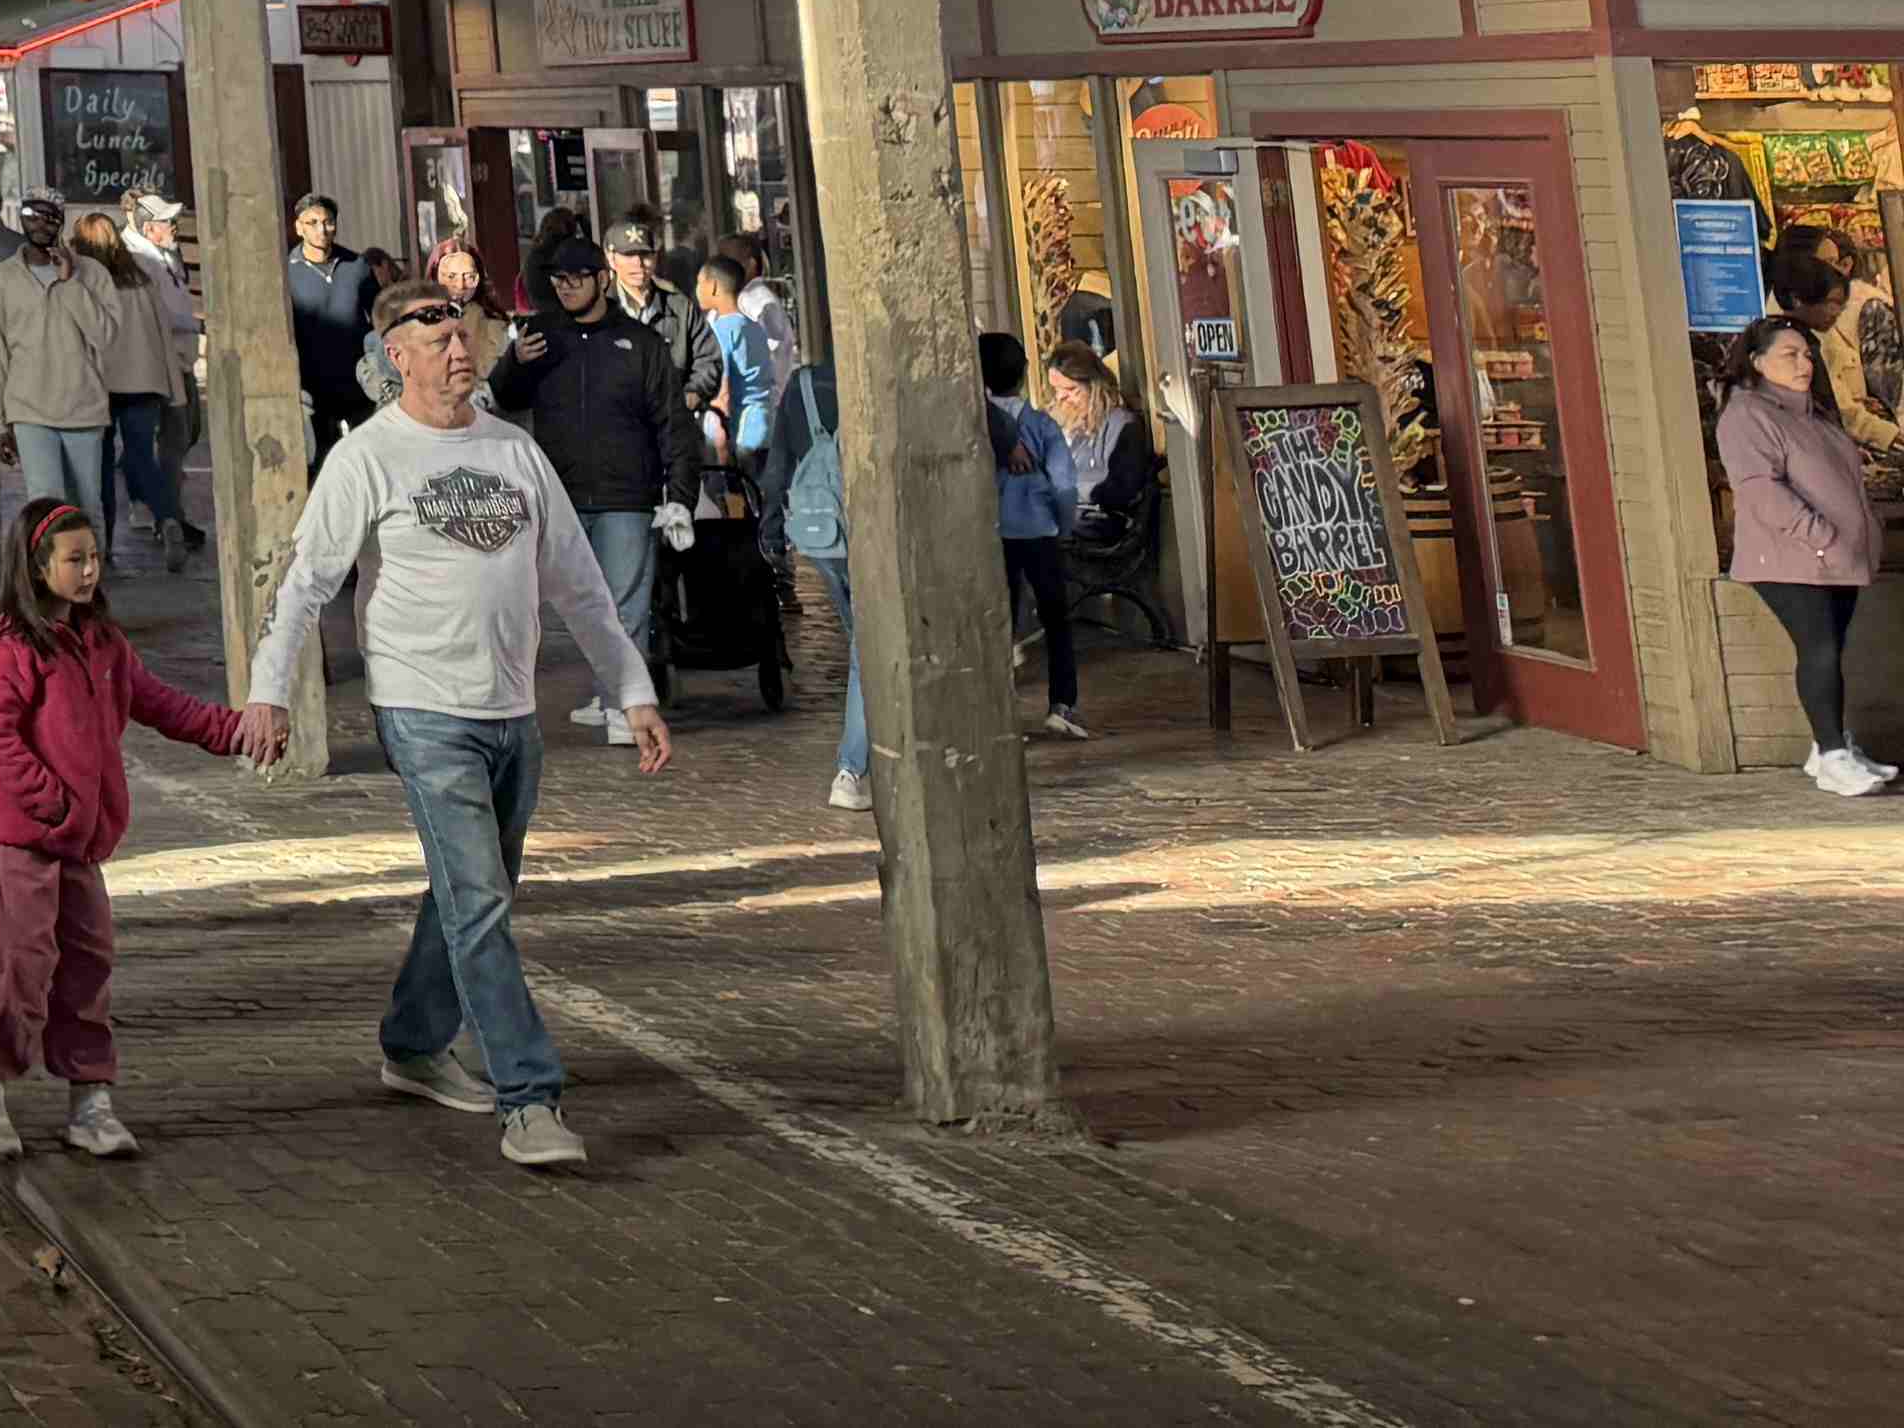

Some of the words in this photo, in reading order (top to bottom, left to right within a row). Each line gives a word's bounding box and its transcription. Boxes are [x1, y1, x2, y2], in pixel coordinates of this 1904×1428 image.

[623, 8, 682, 50] STUFF
[64, 84, 136, 123] Daily
[76, 121, 154, 150] Lunch
[84, 159, 166, 195] Specials
[1197, 320, 1234, 352] OPEN
[1264, 425, 1328, 465] THE
[1255, 456, 1367, 533] CANDY
[1267, 521, 1388, 580] BARREL
